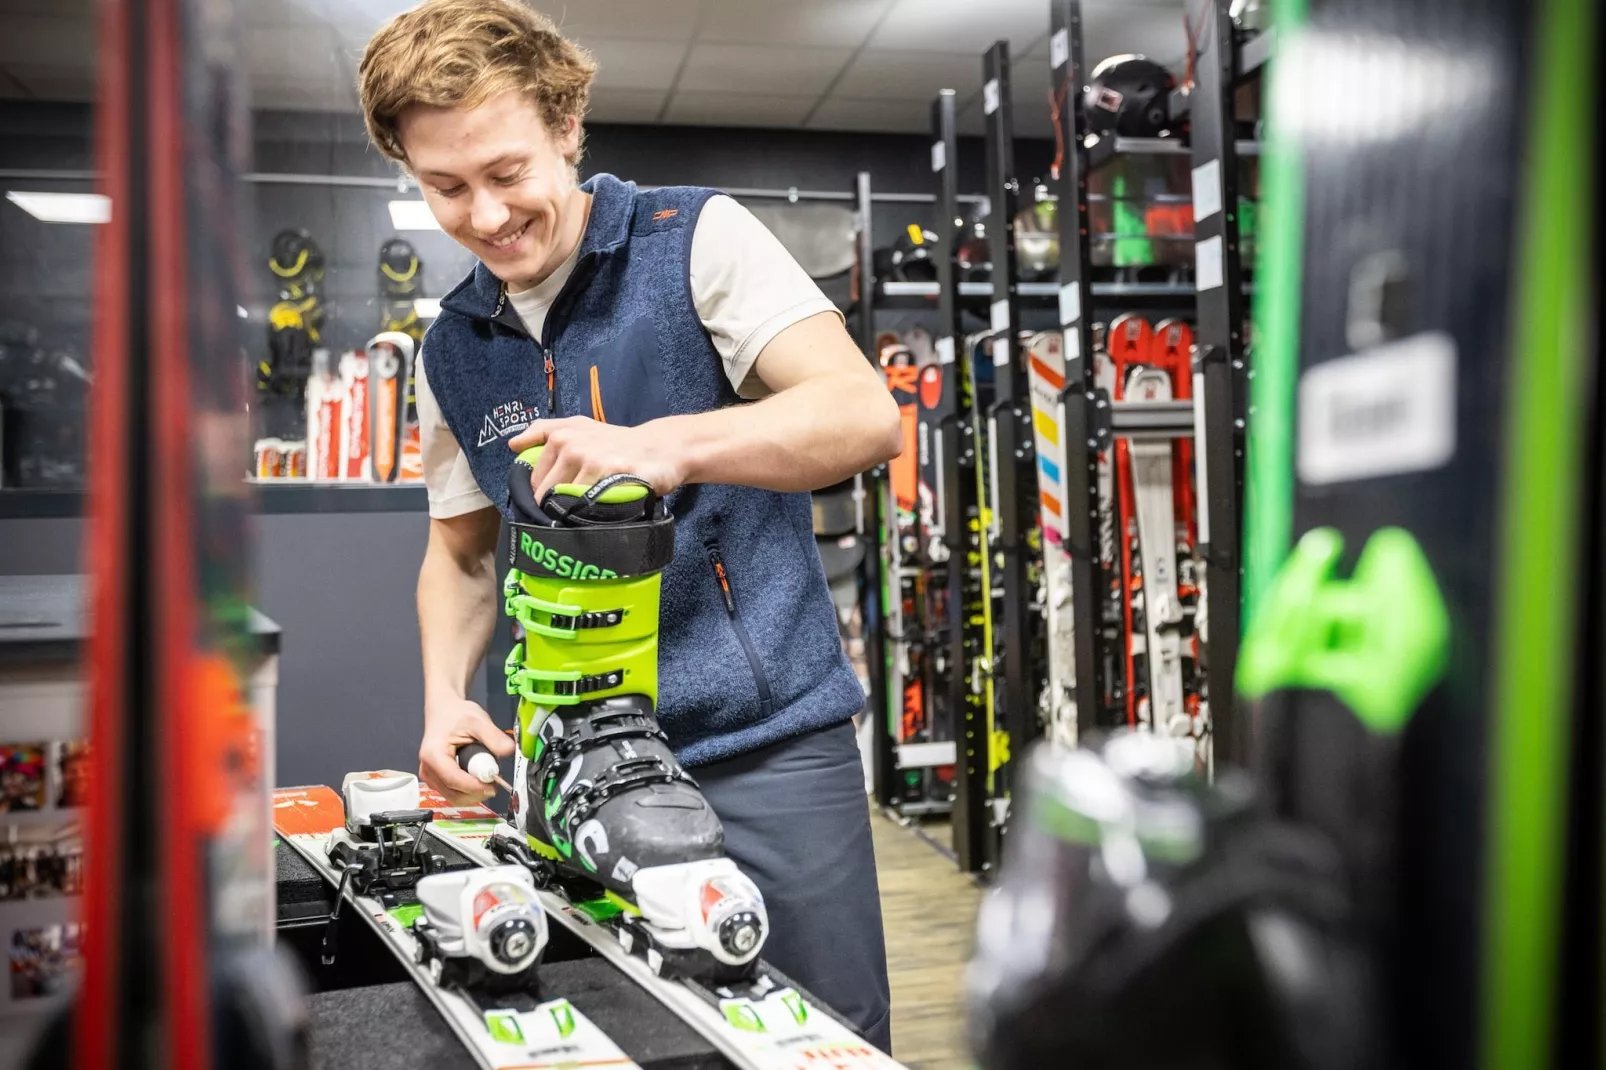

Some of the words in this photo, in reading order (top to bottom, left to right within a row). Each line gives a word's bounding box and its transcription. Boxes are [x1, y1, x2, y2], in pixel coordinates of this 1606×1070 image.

[493, 400, 523, 419] HENRI
[500, 406, 540, 428] SPORTS
[587, 476, 614, 499] CUSTOM
